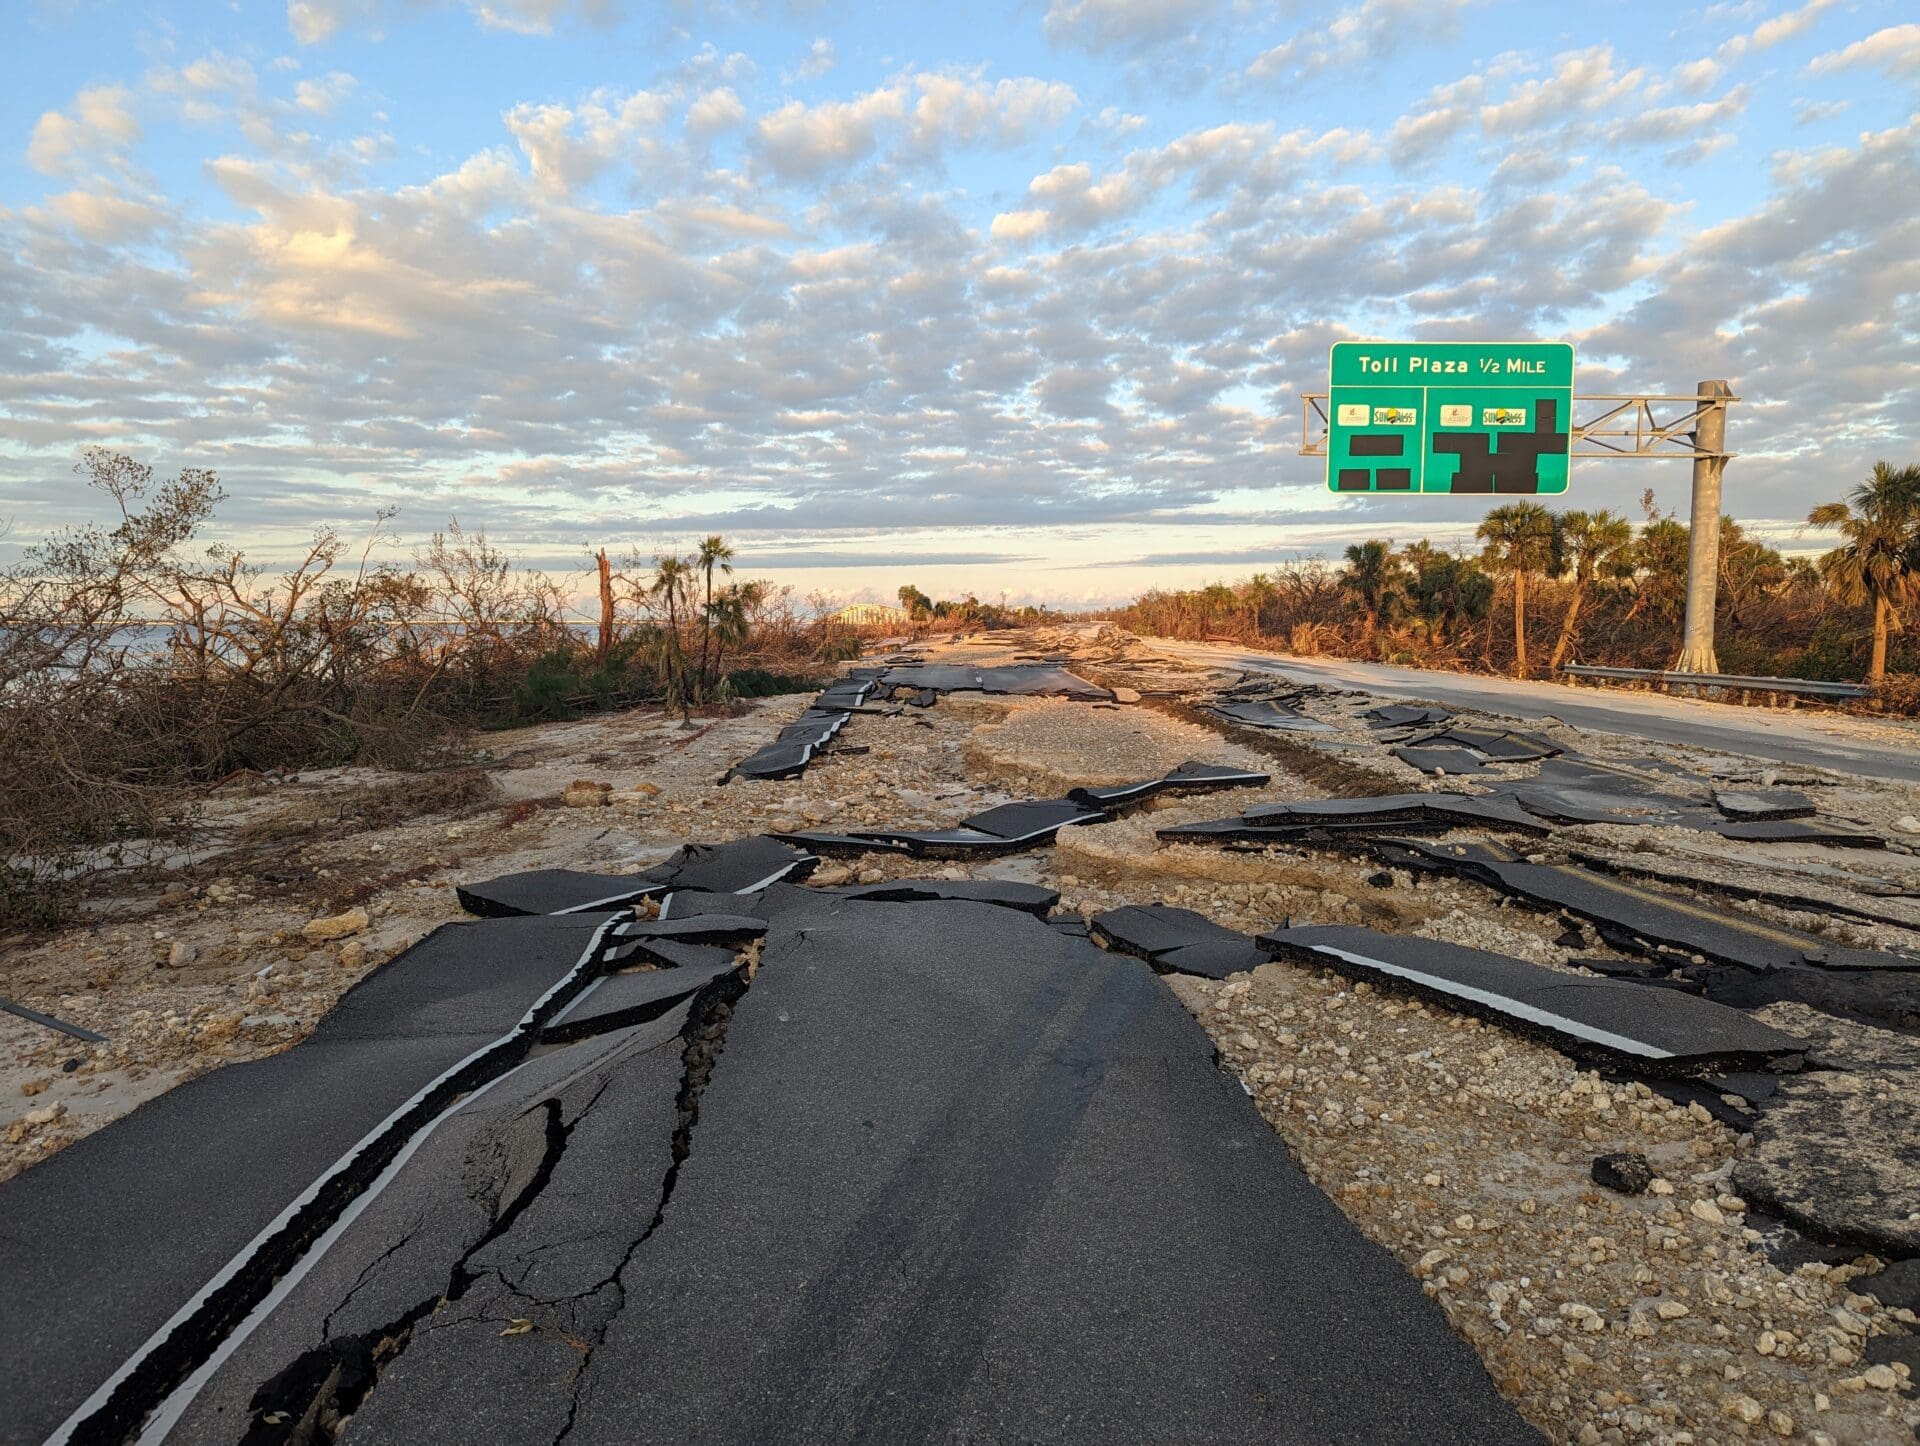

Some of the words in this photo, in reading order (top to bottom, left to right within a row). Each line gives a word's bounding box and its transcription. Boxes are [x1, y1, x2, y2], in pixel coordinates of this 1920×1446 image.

[1359, 357, 1397, 373] Toll
[1409, 357, 1468, 373] Plaza
[1506, 358, 1546, 373] MILE
